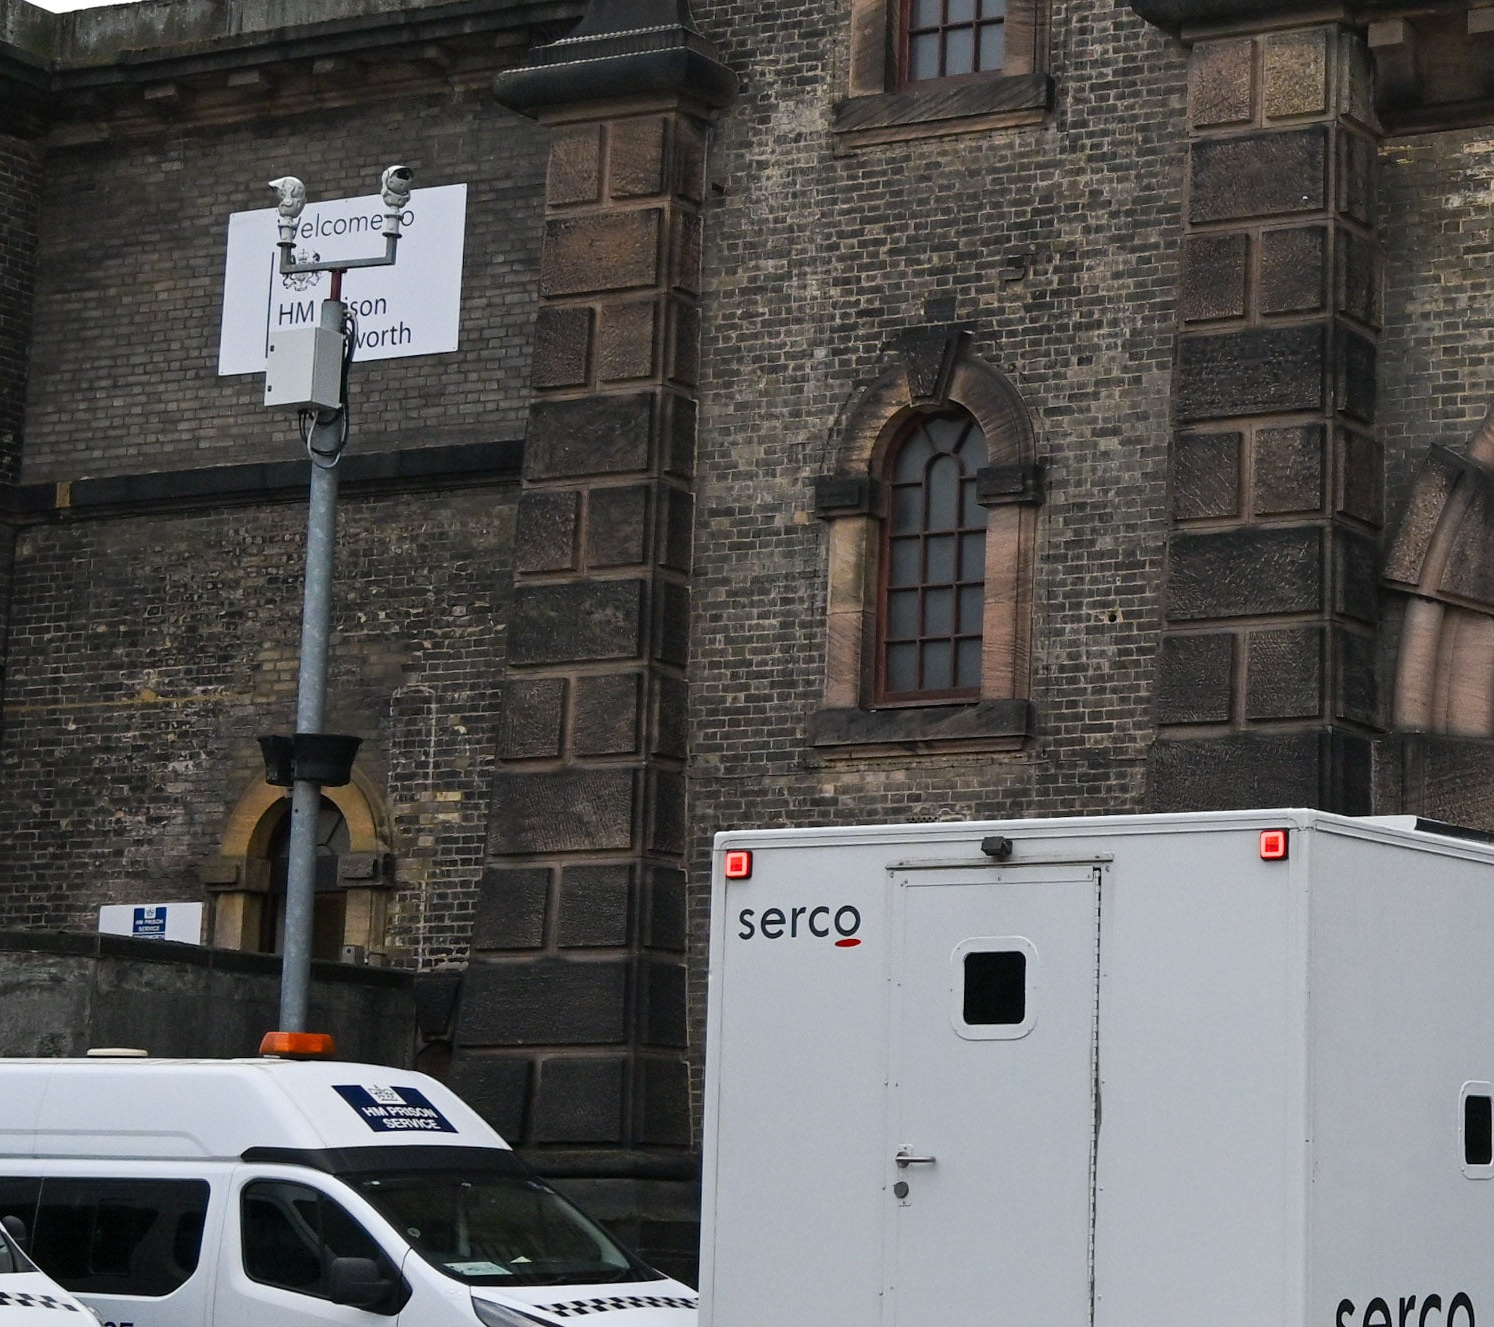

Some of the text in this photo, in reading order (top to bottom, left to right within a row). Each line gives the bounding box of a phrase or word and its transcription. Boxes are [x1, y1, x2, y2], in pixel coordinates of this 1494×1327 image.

[278, 300, 314, 325] HM
[738, 905, 861, 940] serco
[361, 1106, 439, 1118] HM PRISON
[382, 1118, 442, 1130] SERVICE
